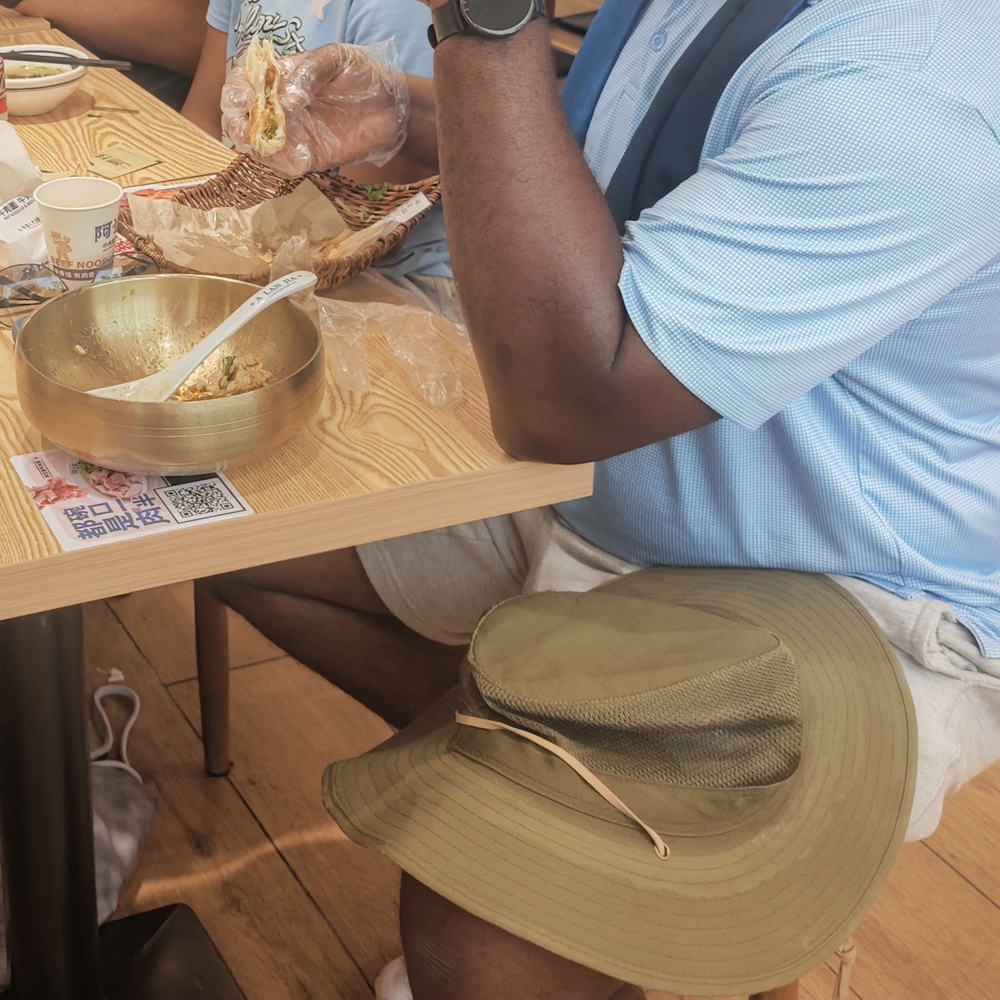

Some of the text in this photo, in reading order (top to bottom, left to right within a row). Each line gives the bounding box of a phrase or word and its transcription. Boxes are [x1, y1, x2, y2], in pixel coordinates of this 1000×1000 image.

[63, 493, 157, 522] 碗口一半
[71, 506, 171, 540] 都是肉
